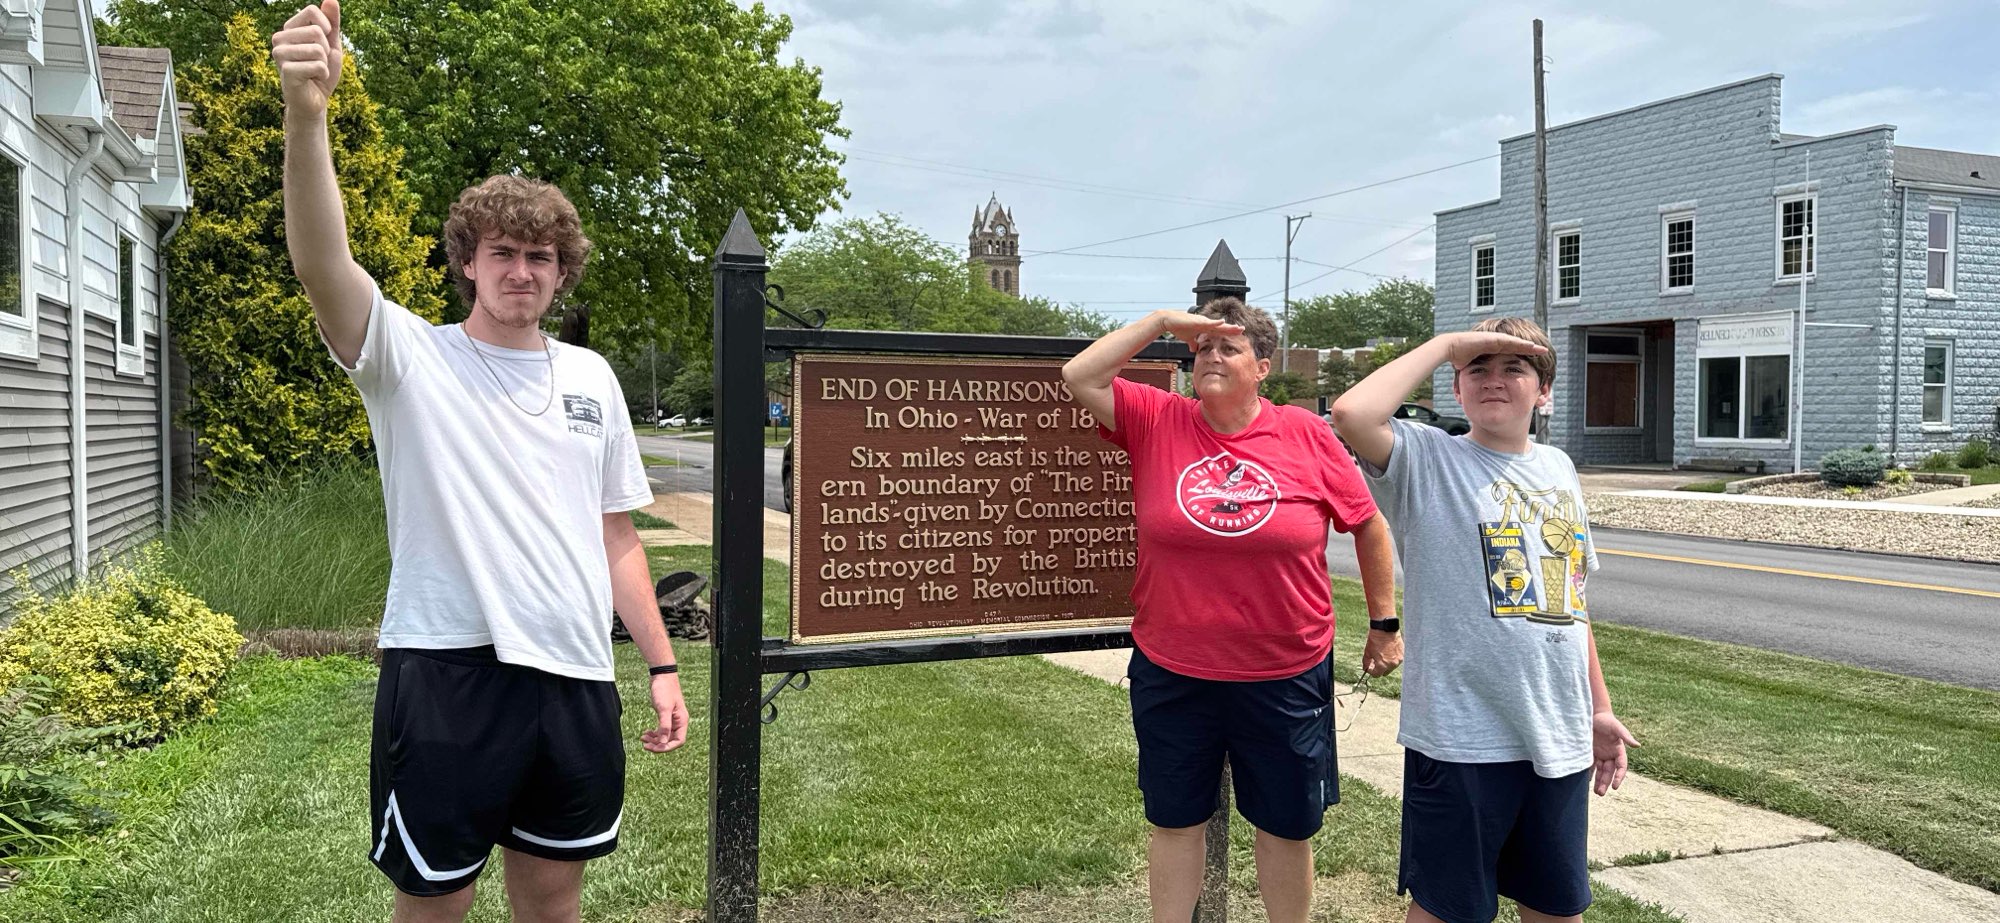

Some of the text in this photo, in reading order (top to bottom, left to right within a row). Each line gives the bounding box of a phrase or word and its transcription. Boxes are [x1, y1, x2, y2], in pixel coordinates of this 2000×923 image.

[821, 377, 1074, 403] END OF HARRISON'S
[865, 406, 890, 428] In
[898, 405, 958, 429] Ohio
[977, 407, 1028, 429] War
[1037, 407, 1062, 429] of
[1070, 407, 1099, 429] 18
[850, 445, 1132, 468] Six miles east is the we
[1190, 460, 1230, 480] TRIPLE
[820, 480, 867, 497] ern
[878, 473, 1001, 499] boundary
[1009, 471, 1035, 493] of
[1187, 479, 1269, 504] Louisville
[978, 499, 1009, 525] by
[1191, 504, 1261, 528] OF RUNNING
[820, 531, 847, 552] to
[857, 530, 887, 551] its
[898, 528, 993, 549] citizens
[1003, 524, 1038, 546] for
[1491, 537, 1521, 548] INDIANA
[819, 547, 1139, 580] destroyed by the Britis
[819, 576, 1099, 610] during the Revolution.
